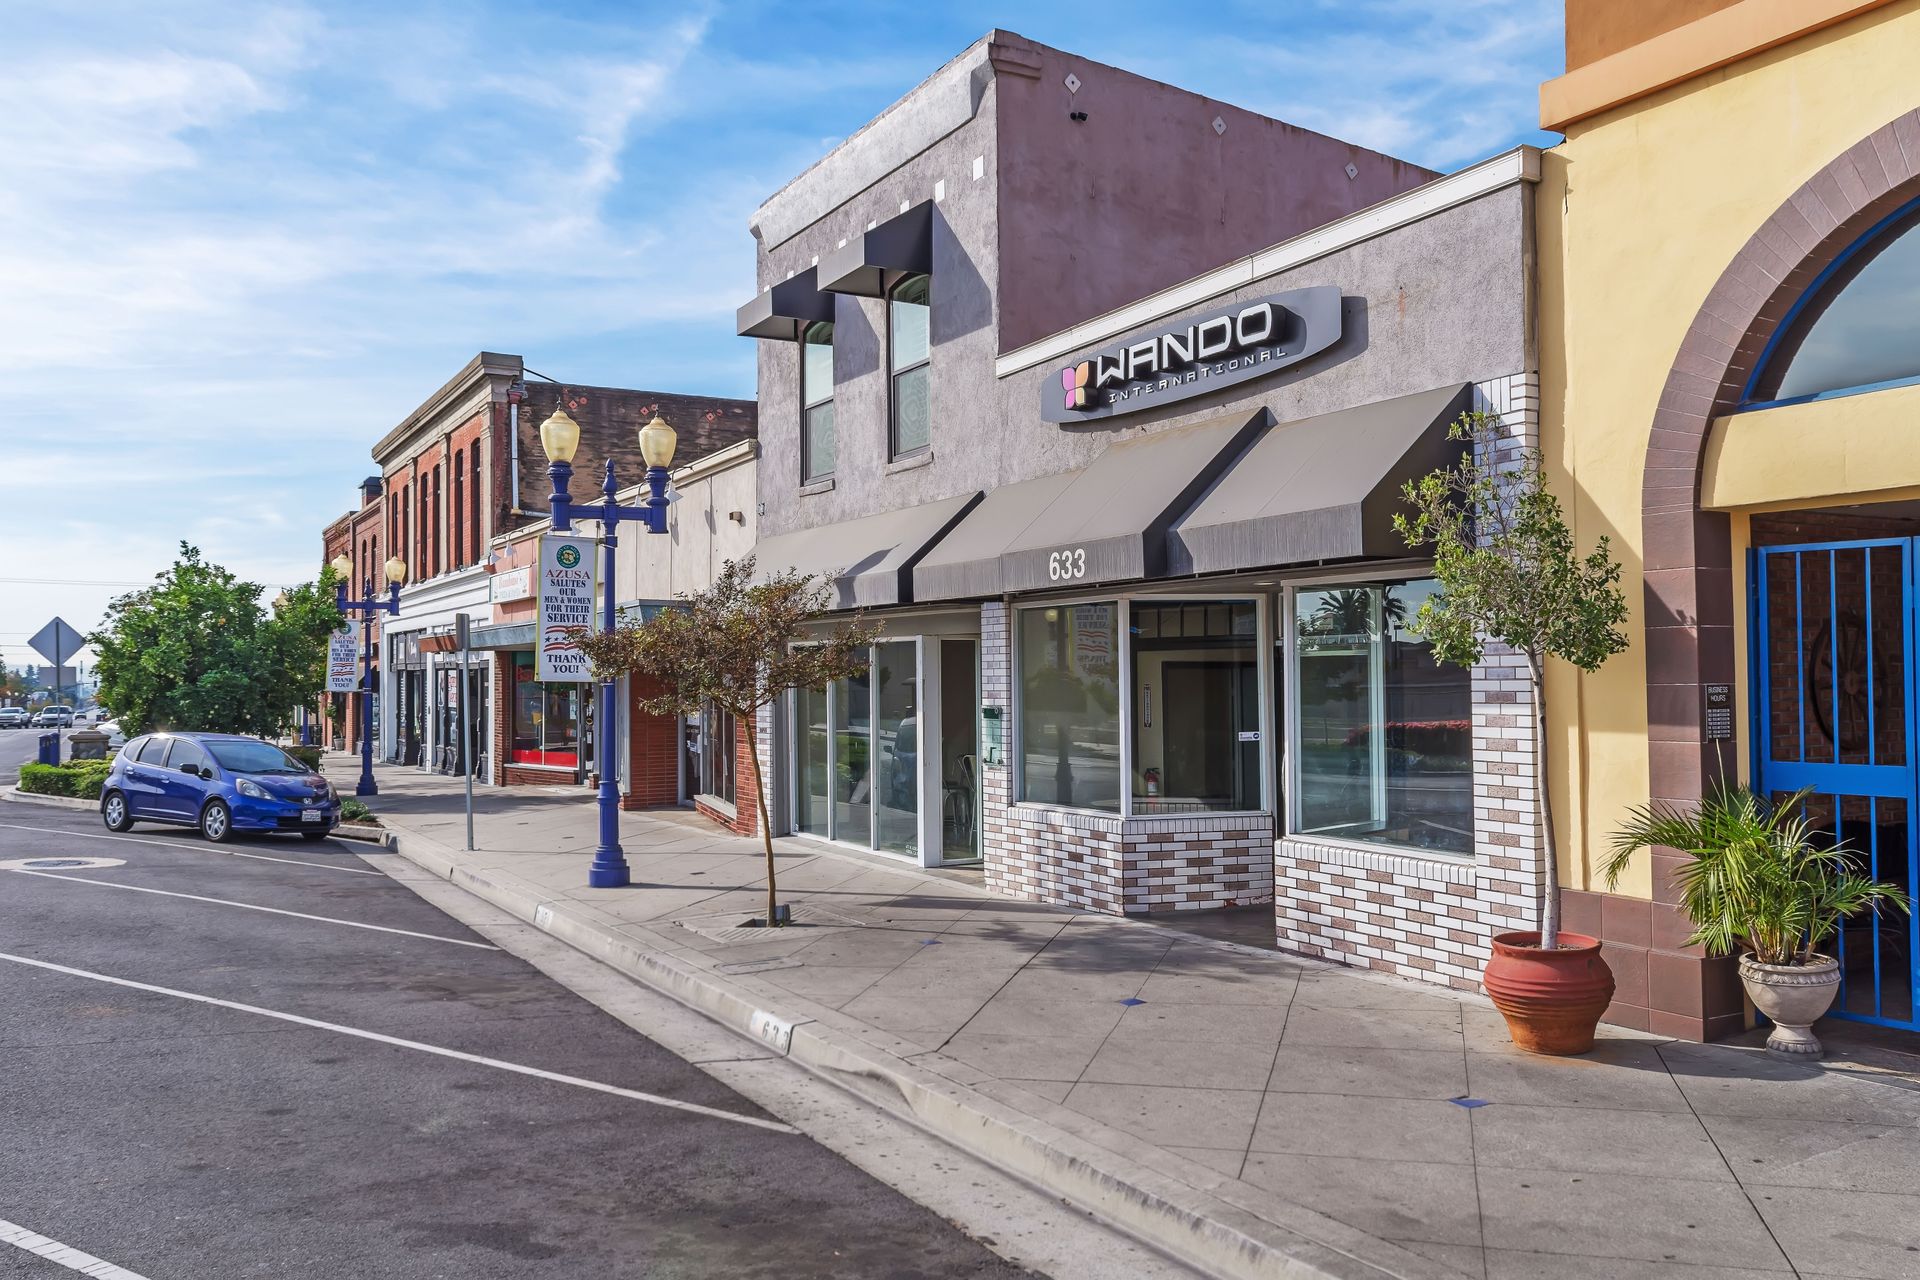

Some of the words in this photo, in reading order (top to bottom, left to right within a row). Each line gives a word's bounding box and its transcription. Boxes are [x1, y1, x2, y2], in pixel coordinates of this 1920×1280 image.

[1096, 302, 1272, 388] WANDO
[1109, 347, 1287, 403] INTERNATIONAL
[1049, 548, 1085, 580] 633
[545, 569, 590, 579] AZUSA
[550, 579, 586, 588] SALUTES
[559, 588, 577, 596] OUR
[567, 597, 591, 605] WOMEN
[546, 604, 562, 612] FOR
[565, 605, 590, 613] THEIR
[547, 613, 588, 623] SERVICE
[547, 654, 586, 663] THANK
[553, 665, 579, 673] YOU!
